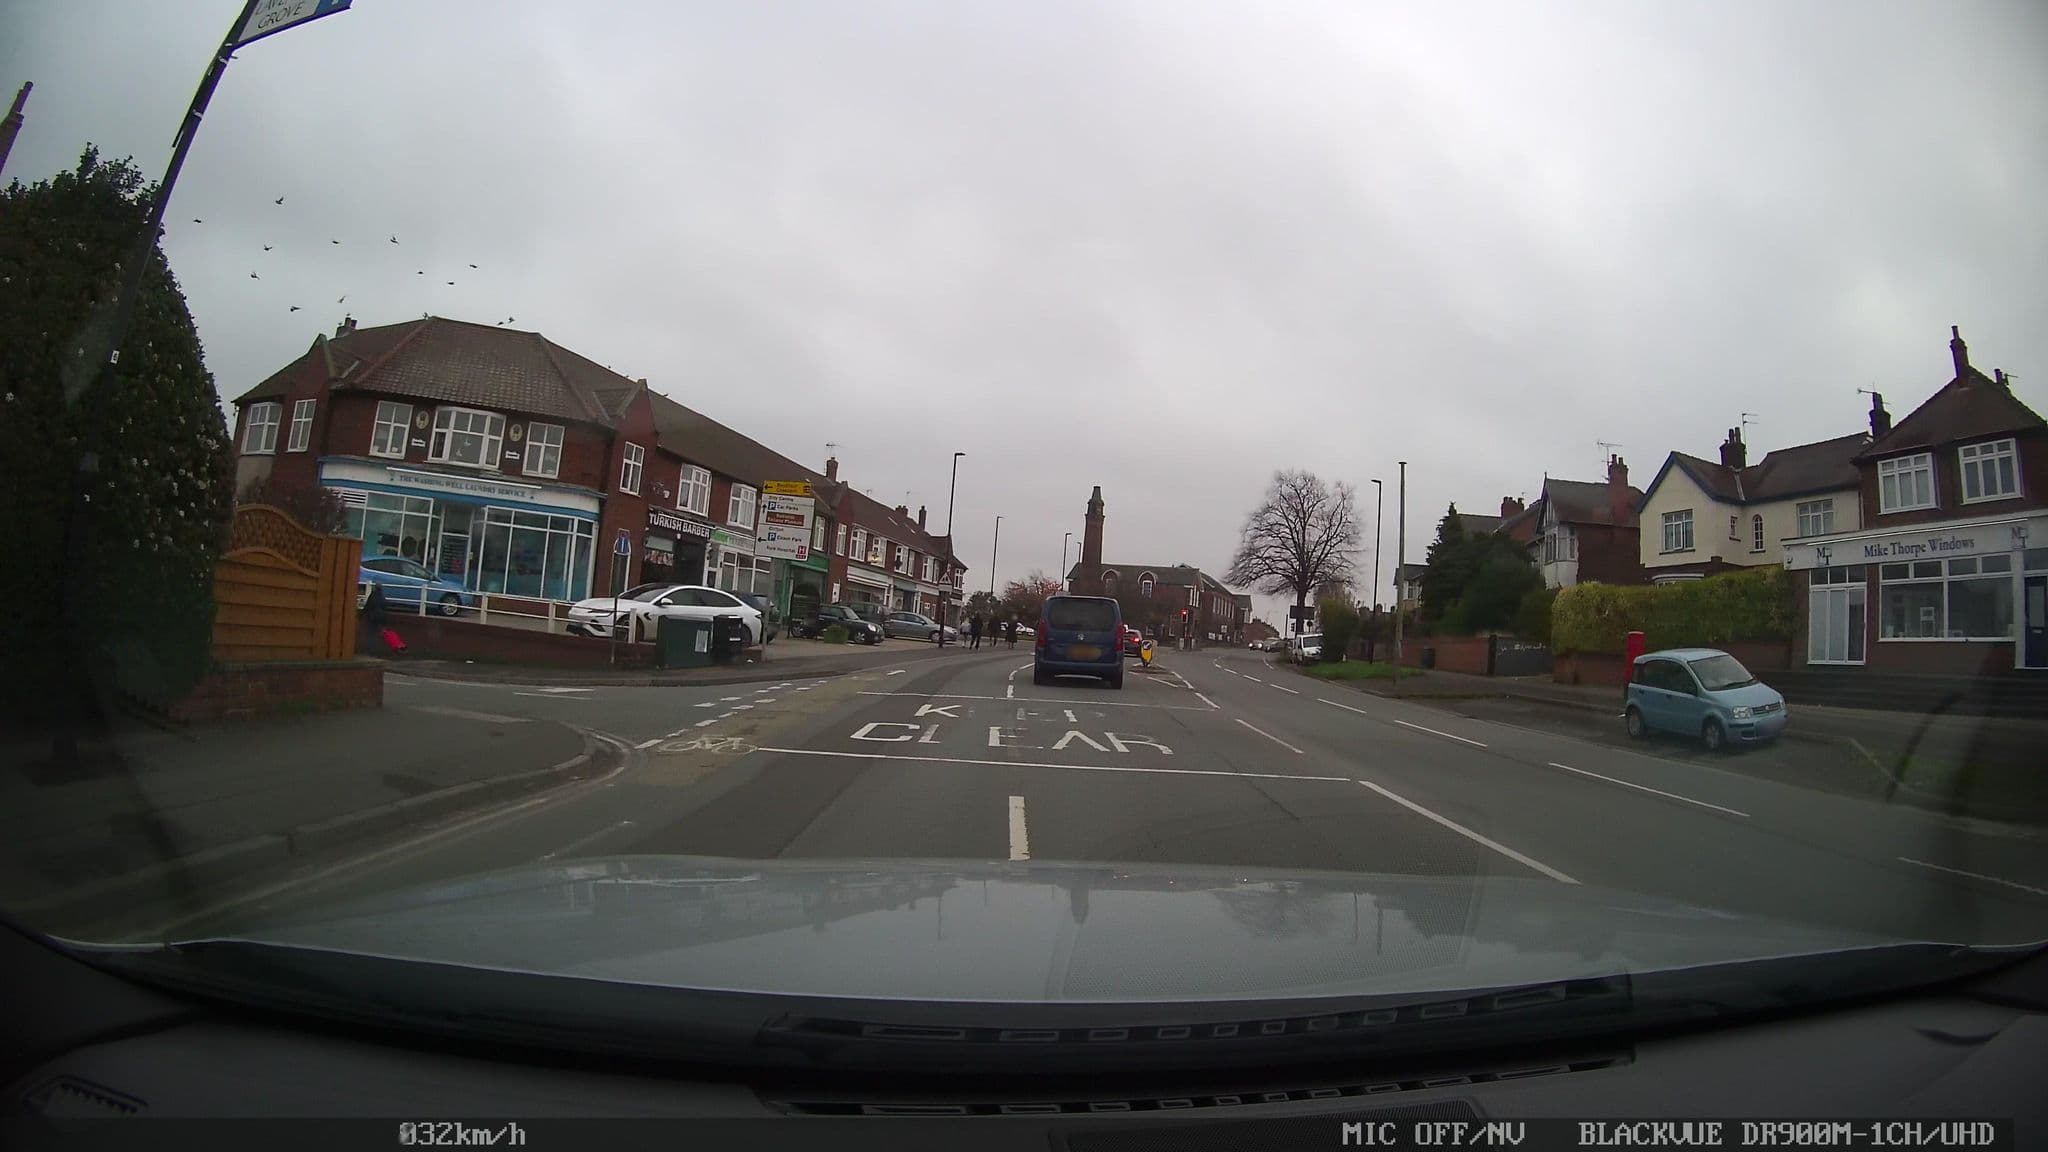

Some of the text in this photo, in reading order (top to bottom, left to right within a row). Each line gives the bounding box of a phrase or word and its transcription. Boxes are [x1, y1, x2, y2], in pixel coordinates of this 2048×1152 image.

[257, 1, 304, 29] GROVE
[445, 480, 464, 490] WELL
[465, 483, 496, 494] LAUNDRY
[497, 487, 526, 498] SERVICE
[649, 513, 682, 532] TURKISH
[682, 523, 710, 539] BARBER
[1864, 536, 1975, 558] Mike Thorpe Windows
[850, 722, 1174, 755] CLEAR
